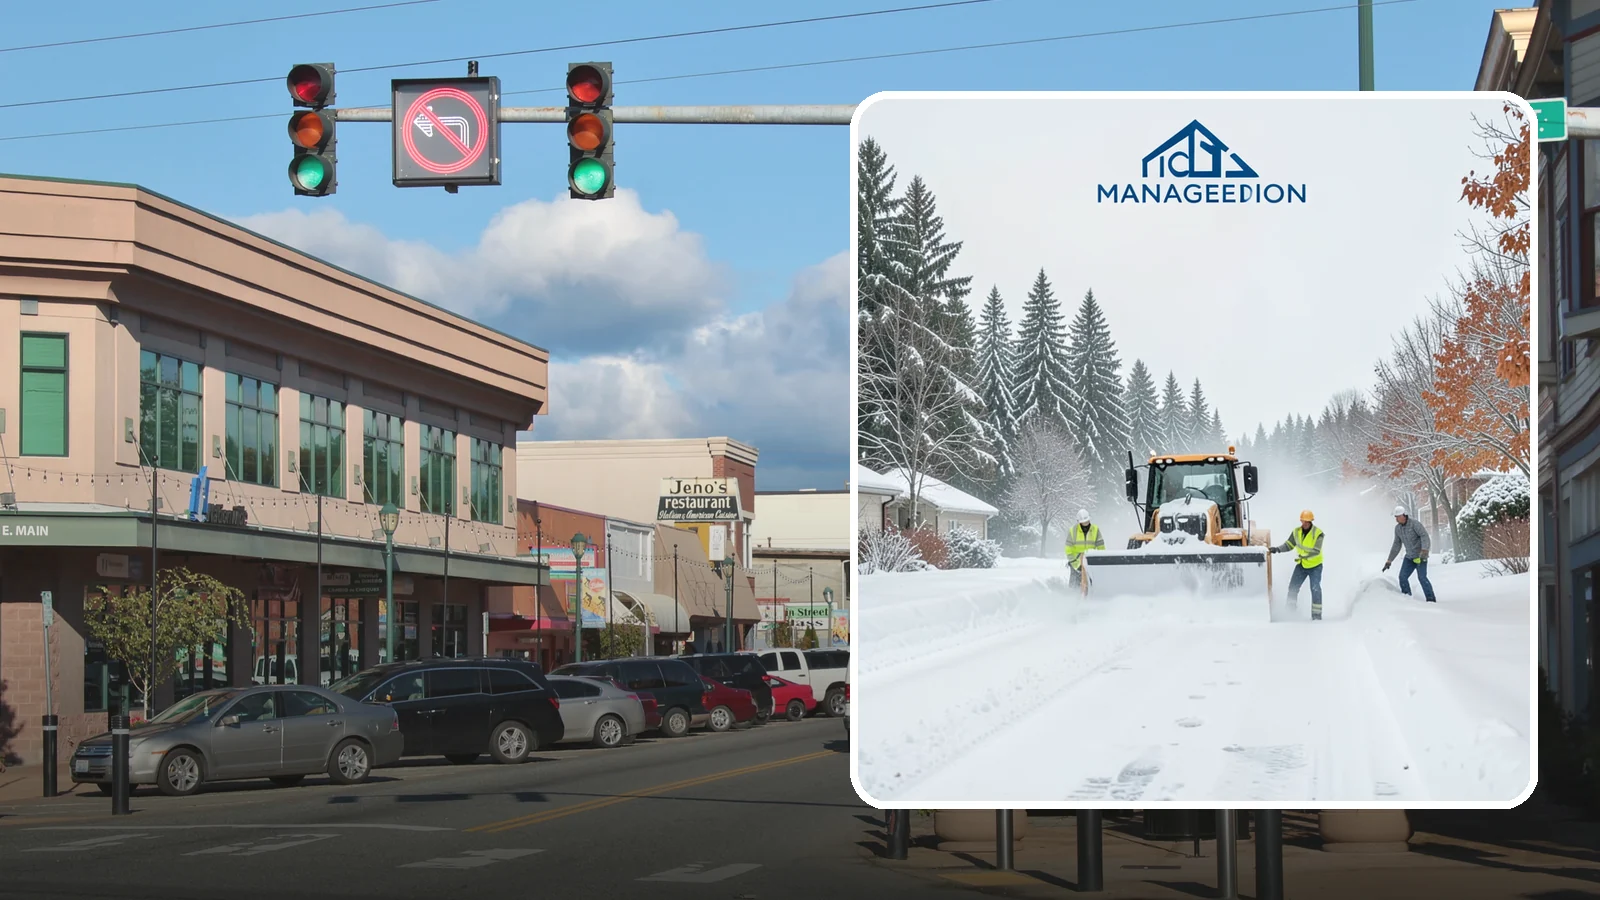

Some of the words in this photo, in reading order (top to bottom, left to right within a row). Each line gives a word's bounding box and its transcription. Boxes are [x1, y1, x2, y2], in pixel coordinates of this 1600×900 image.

[669, 480, 728, 495] Jeno's
[664, 496, 731, 509] restaurant
[686, 509, 714, 520] American
[715, 509, 738, 520] Cuisine
[2, 525, 13, 536] E.
[15, 525, 49, 536] MAIN
[797, 607, 828, 617] Street
